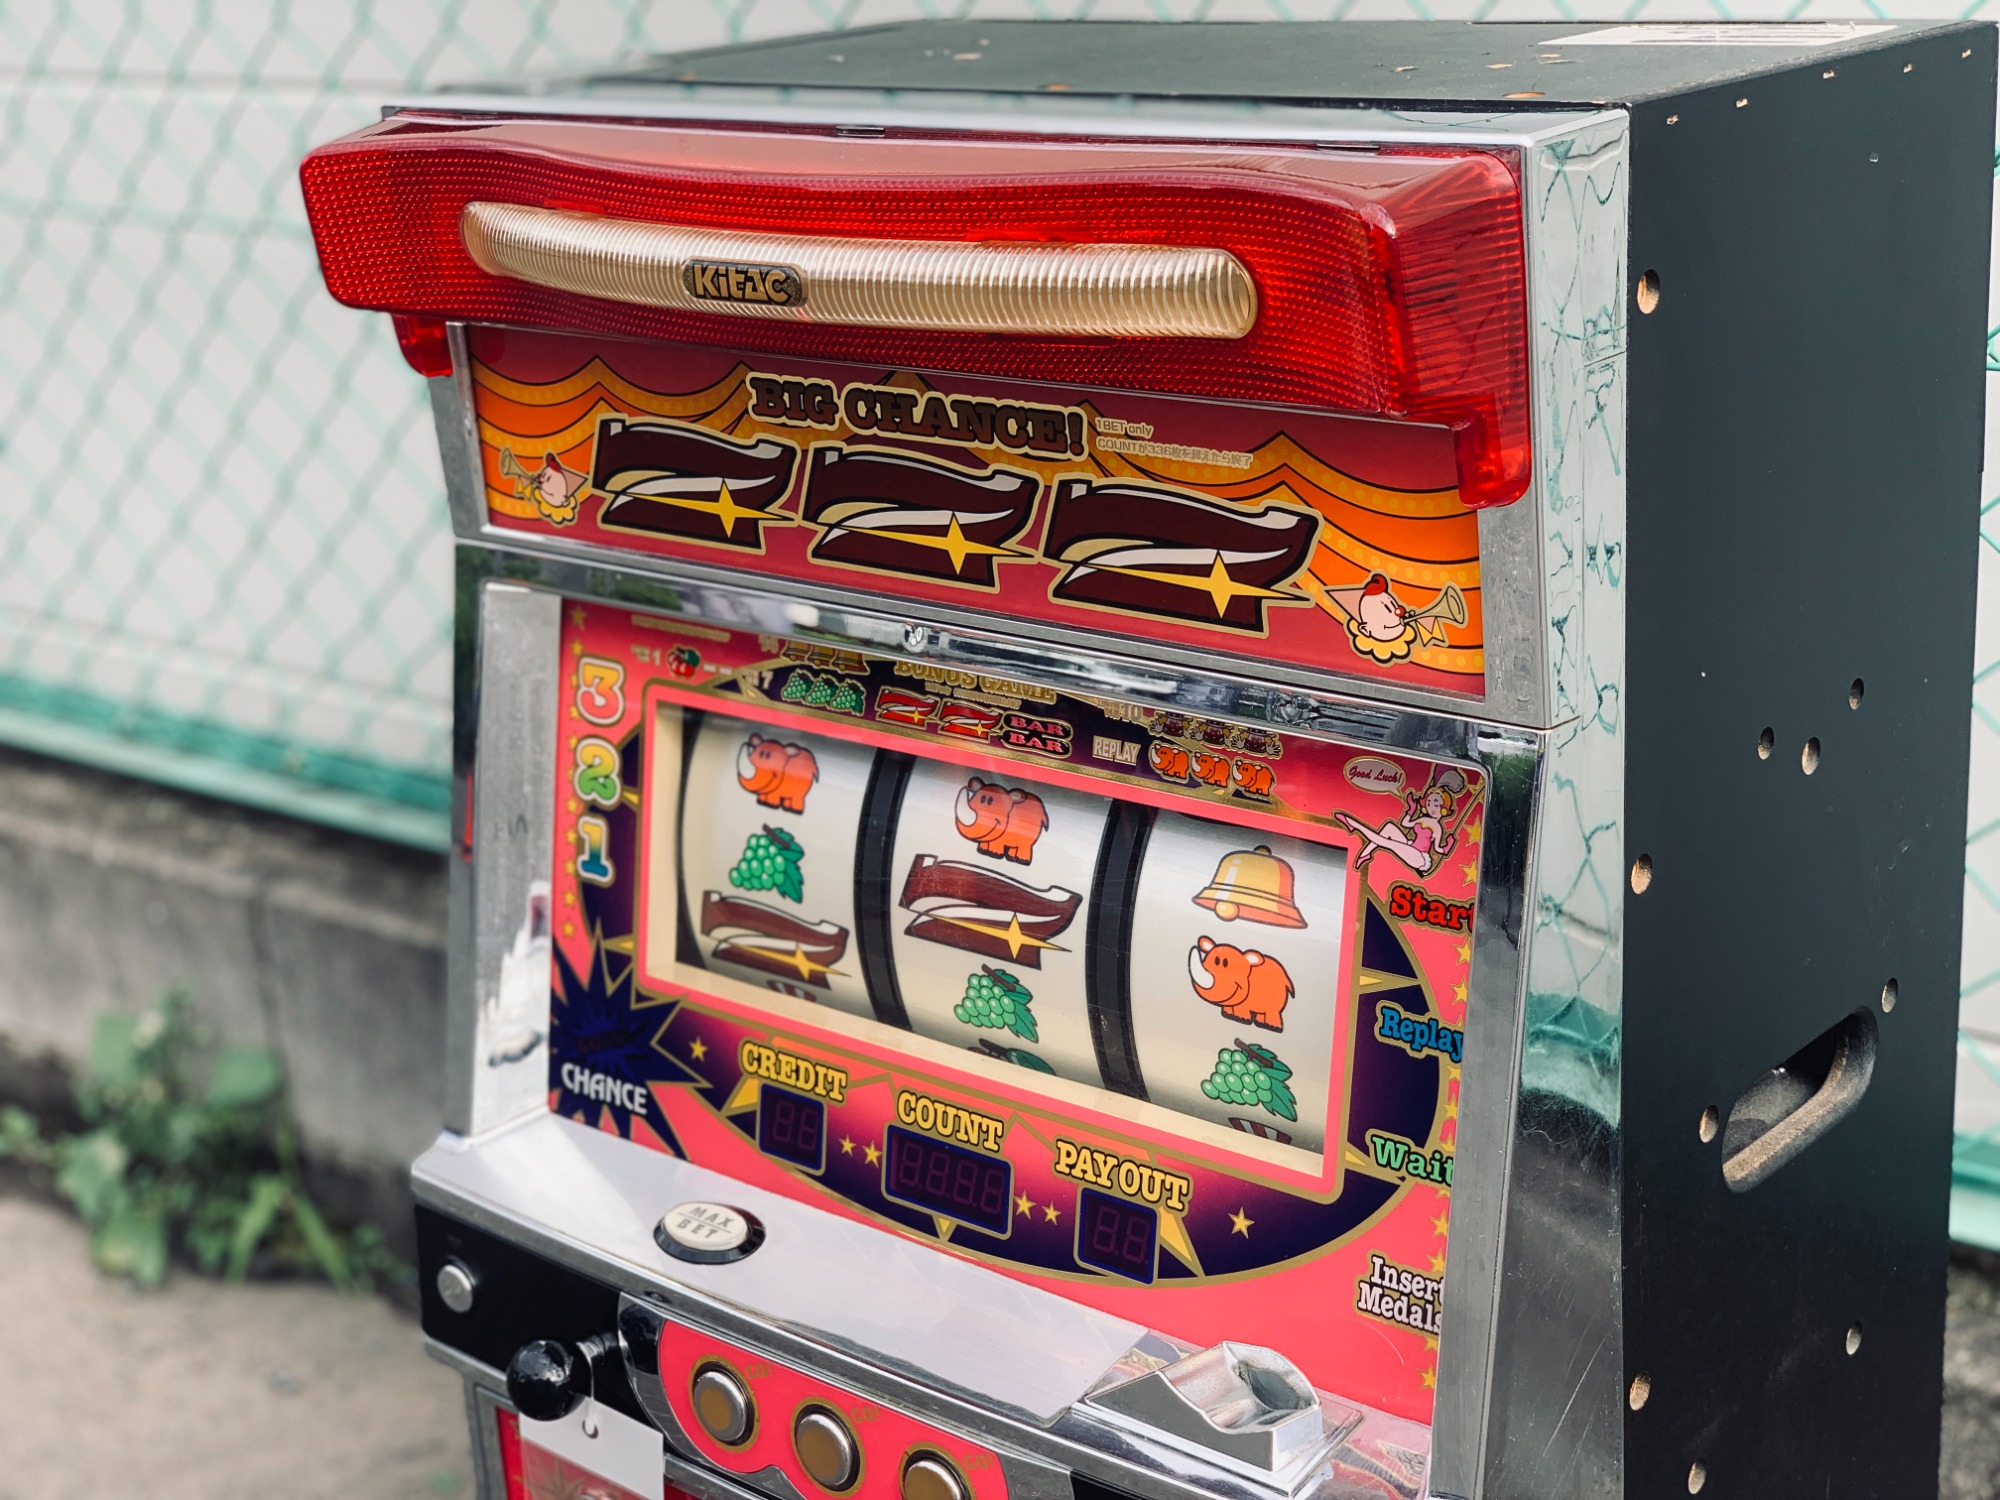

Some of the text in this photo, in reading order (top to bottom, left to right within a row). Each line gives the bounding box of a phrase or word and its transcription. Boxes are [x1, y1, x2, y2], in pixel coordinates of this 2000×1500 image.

[747, 374, 1087, 459] BIG CHANCE!
[1128, 423, 1153, 438] only
[577, 655, 624, 726] 3
[1009, 732, 1064, 753] BAR
[1010, 715, 1065, 737] BAR
[1093, 736, 1140, 765] REPLAY
[573, 735, 622, 807] 2
[1348, 765, 1403, 784] Good Luck!
[576, 814, 613, 884] 1
[560, 1061, 648, 1115] CHANCE
[741, 1040, 847, 1103] CREDIT
[897, 1090, 1003, 1152] COUNT
[1055, 1139, 1190, 1210] PAYOUT
[676, 1218, 719, 1239] BET
[688, 1206, 734, 1228] MAX
